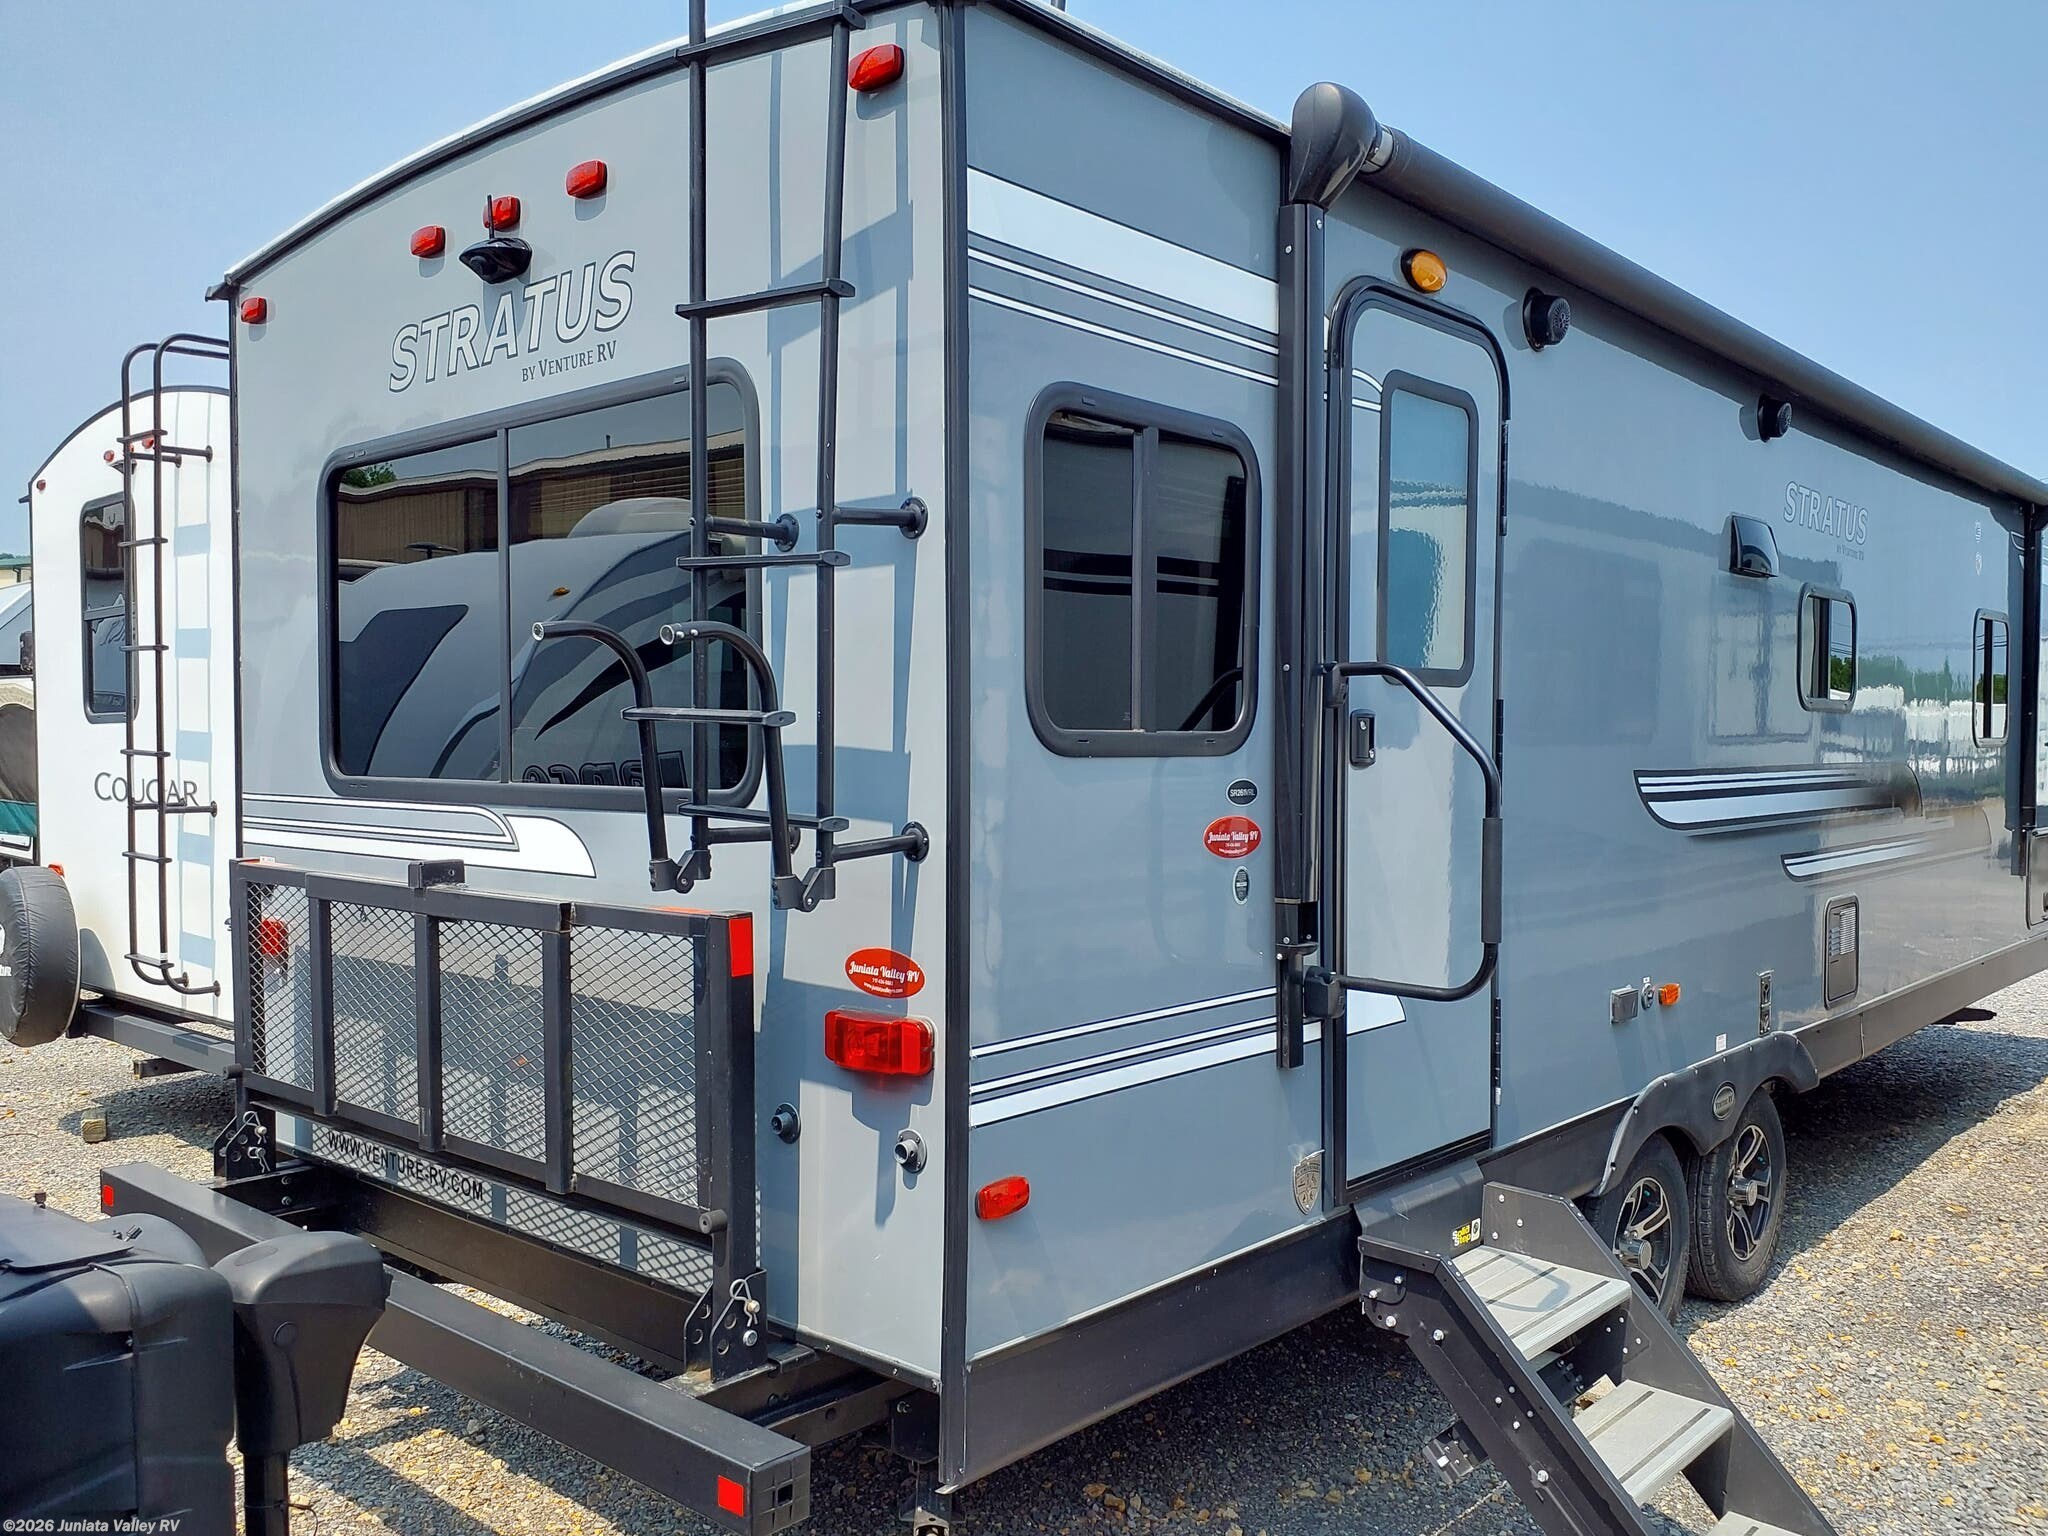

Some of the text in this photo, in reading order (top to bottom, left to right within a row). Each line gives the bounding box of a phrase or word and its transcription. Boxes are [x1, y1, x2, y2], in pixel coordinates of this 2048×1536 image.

[388, 250, 636, 394] STRATUS
[521, 340, 616, 382] BY VENTURE RV
[1783, 481, 1869, 546] STRATUS
[1249, 830, 1259, 841] RV
[848, 961, 880, 976] Juniata
[880, 966, 906, 984] Valley
[906, 970, 920, 983] RV
[327, 1131, 484, 1201] WWW.VENTURE-RV.COM
